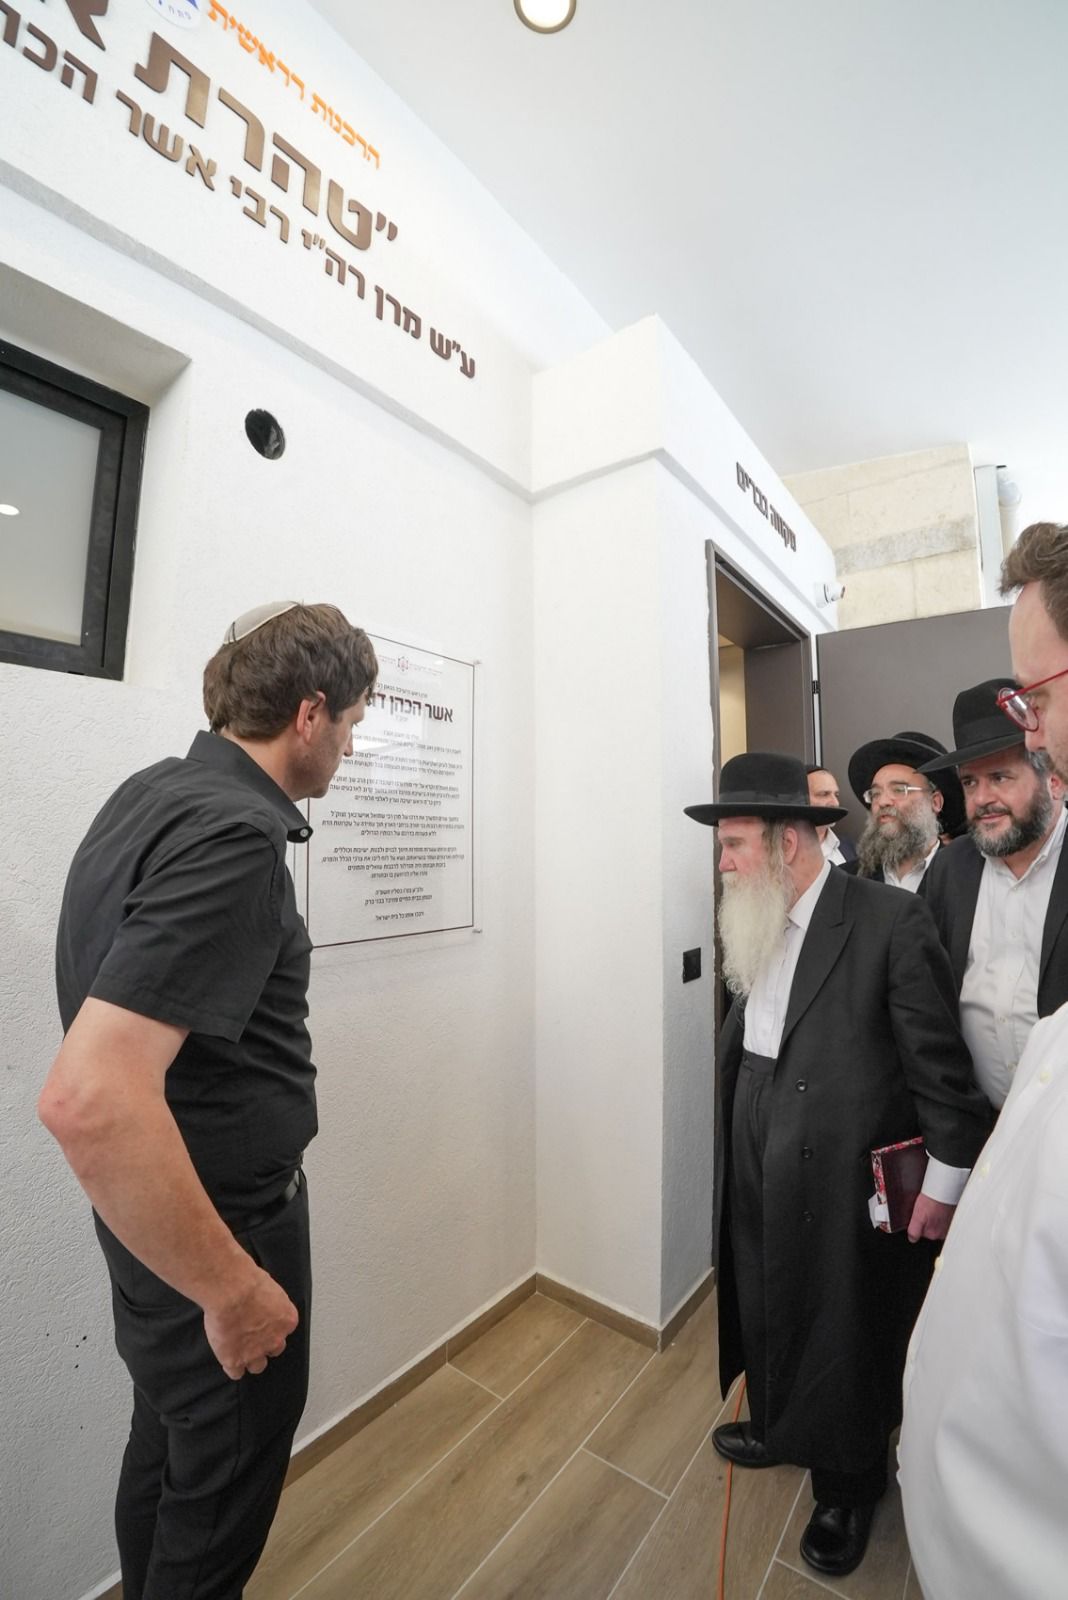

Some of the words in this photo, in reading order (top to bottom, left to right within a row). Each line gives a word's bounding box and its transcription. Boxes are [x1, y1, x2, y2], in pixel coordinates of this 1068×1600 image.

[115, 89, 217, 191] אשר
[311, 92, 380, 170] הרבנות
[229, 174, 290, 244] רבי
[374, 284, 422, 339] מרן
[389, 695, 422, 717] הכהן
[424, 703, 453, 723] אשר
